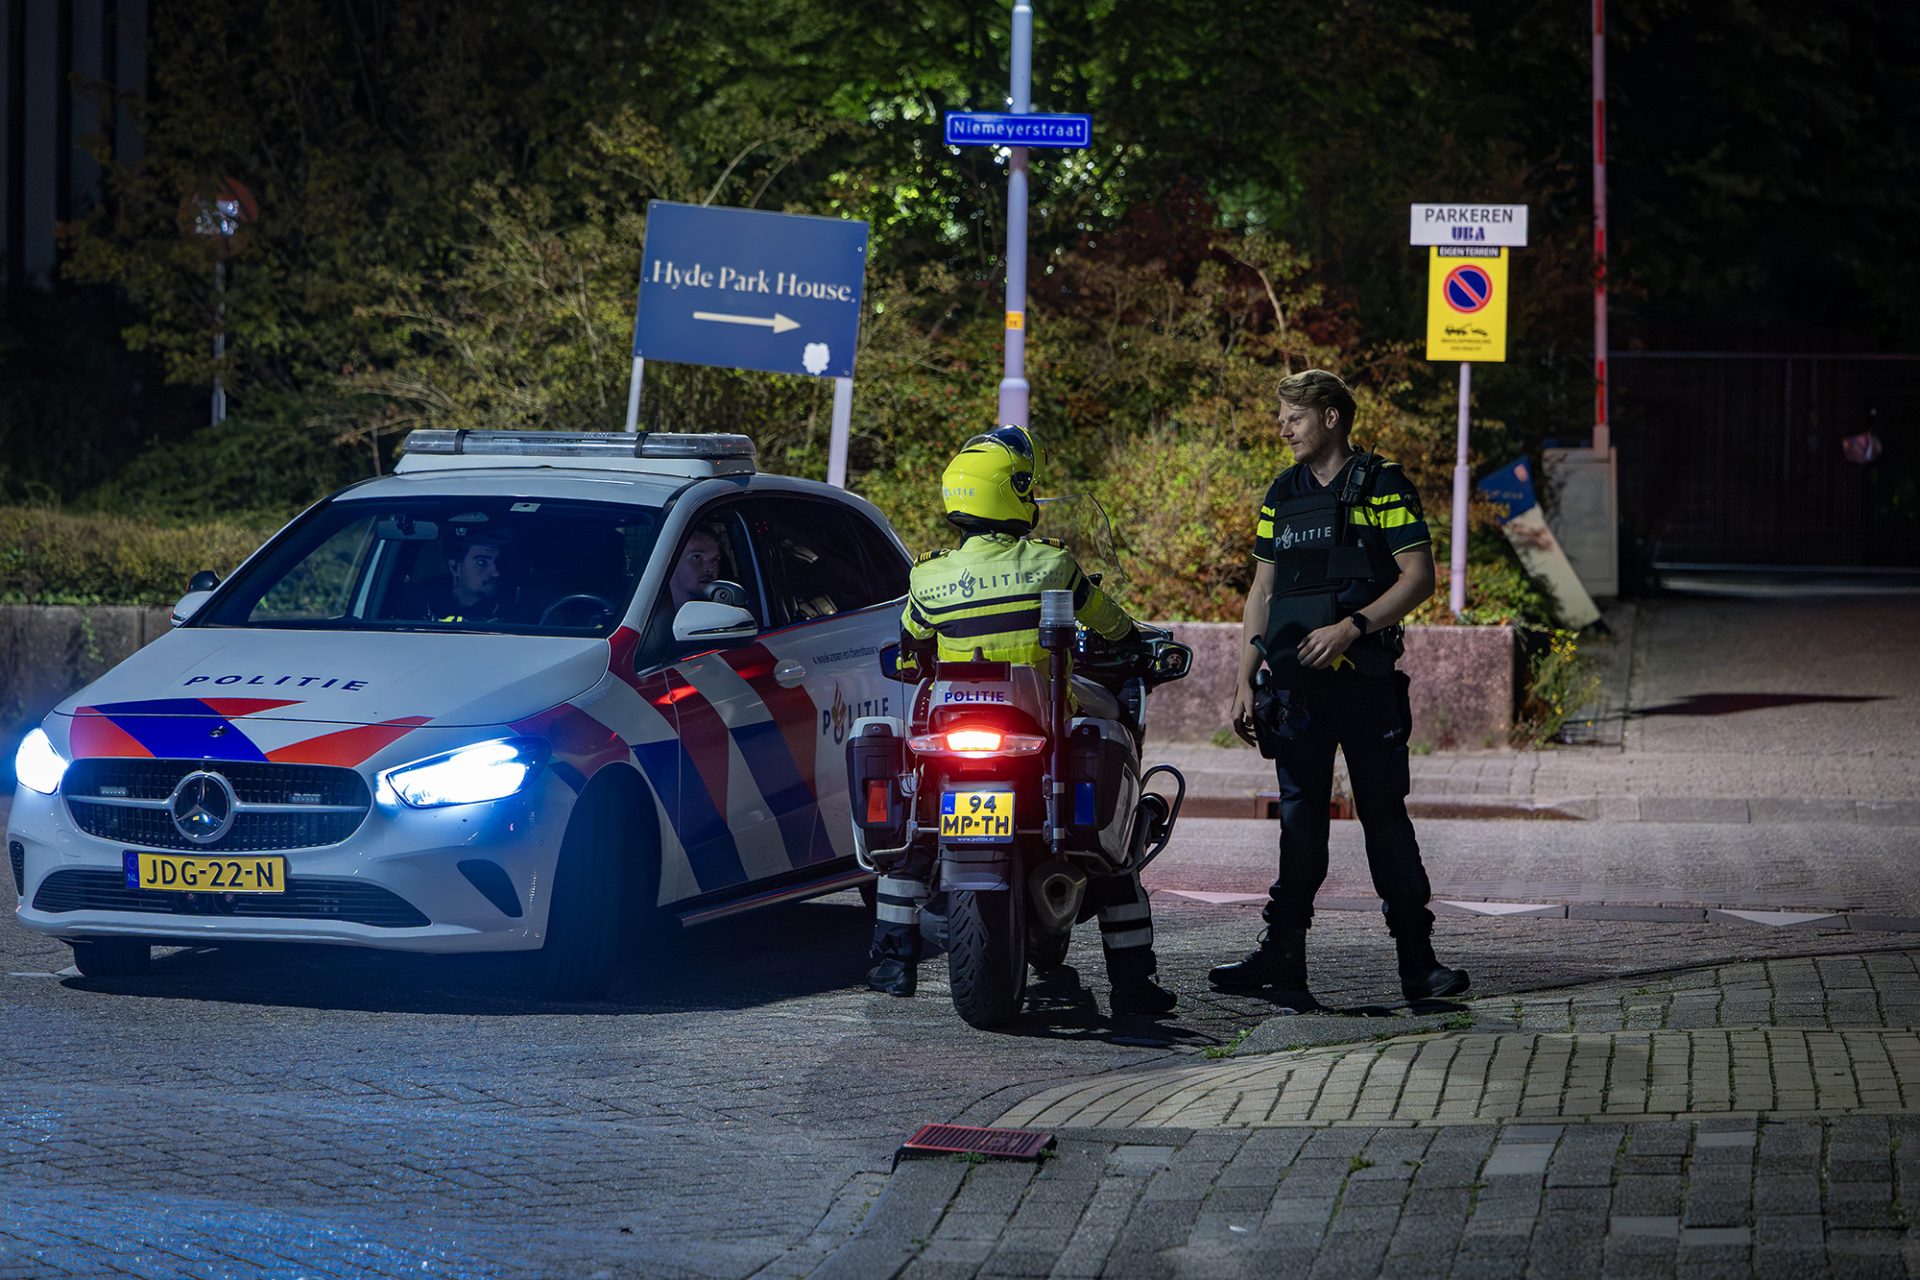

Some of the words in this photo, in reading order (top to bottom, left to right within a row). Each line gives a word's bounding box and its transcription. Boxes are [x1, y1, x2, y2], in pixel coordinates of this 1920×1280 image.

[954, 120, 1082, 138] Niemeyerstraat
[1424, 208, 1513, 224] PARKEREN
[1451, 226, 1486, 241] UBA
[1439, 246, 1464, 257] EIGEN
[1465, 247, 1499, 257] TERREIN
[652, 259, 714, 290] Hyde
[718, 266, 771, 294] Park
[776, 272, 852, 302] House
[1275, 525, 1332, 550] POLITIE
[949, 568, 1035, 599] POLITIE
[183, 675, 369, 692] POLITIE
[944, 690, 1005, 703] POLITIE
[969, 795, 997, 814] 94
[943, 815, 1009, 835] MP-TH
[127, 873, 138, 882] NL
[146, 858, 274, 888] JDG-22-N
